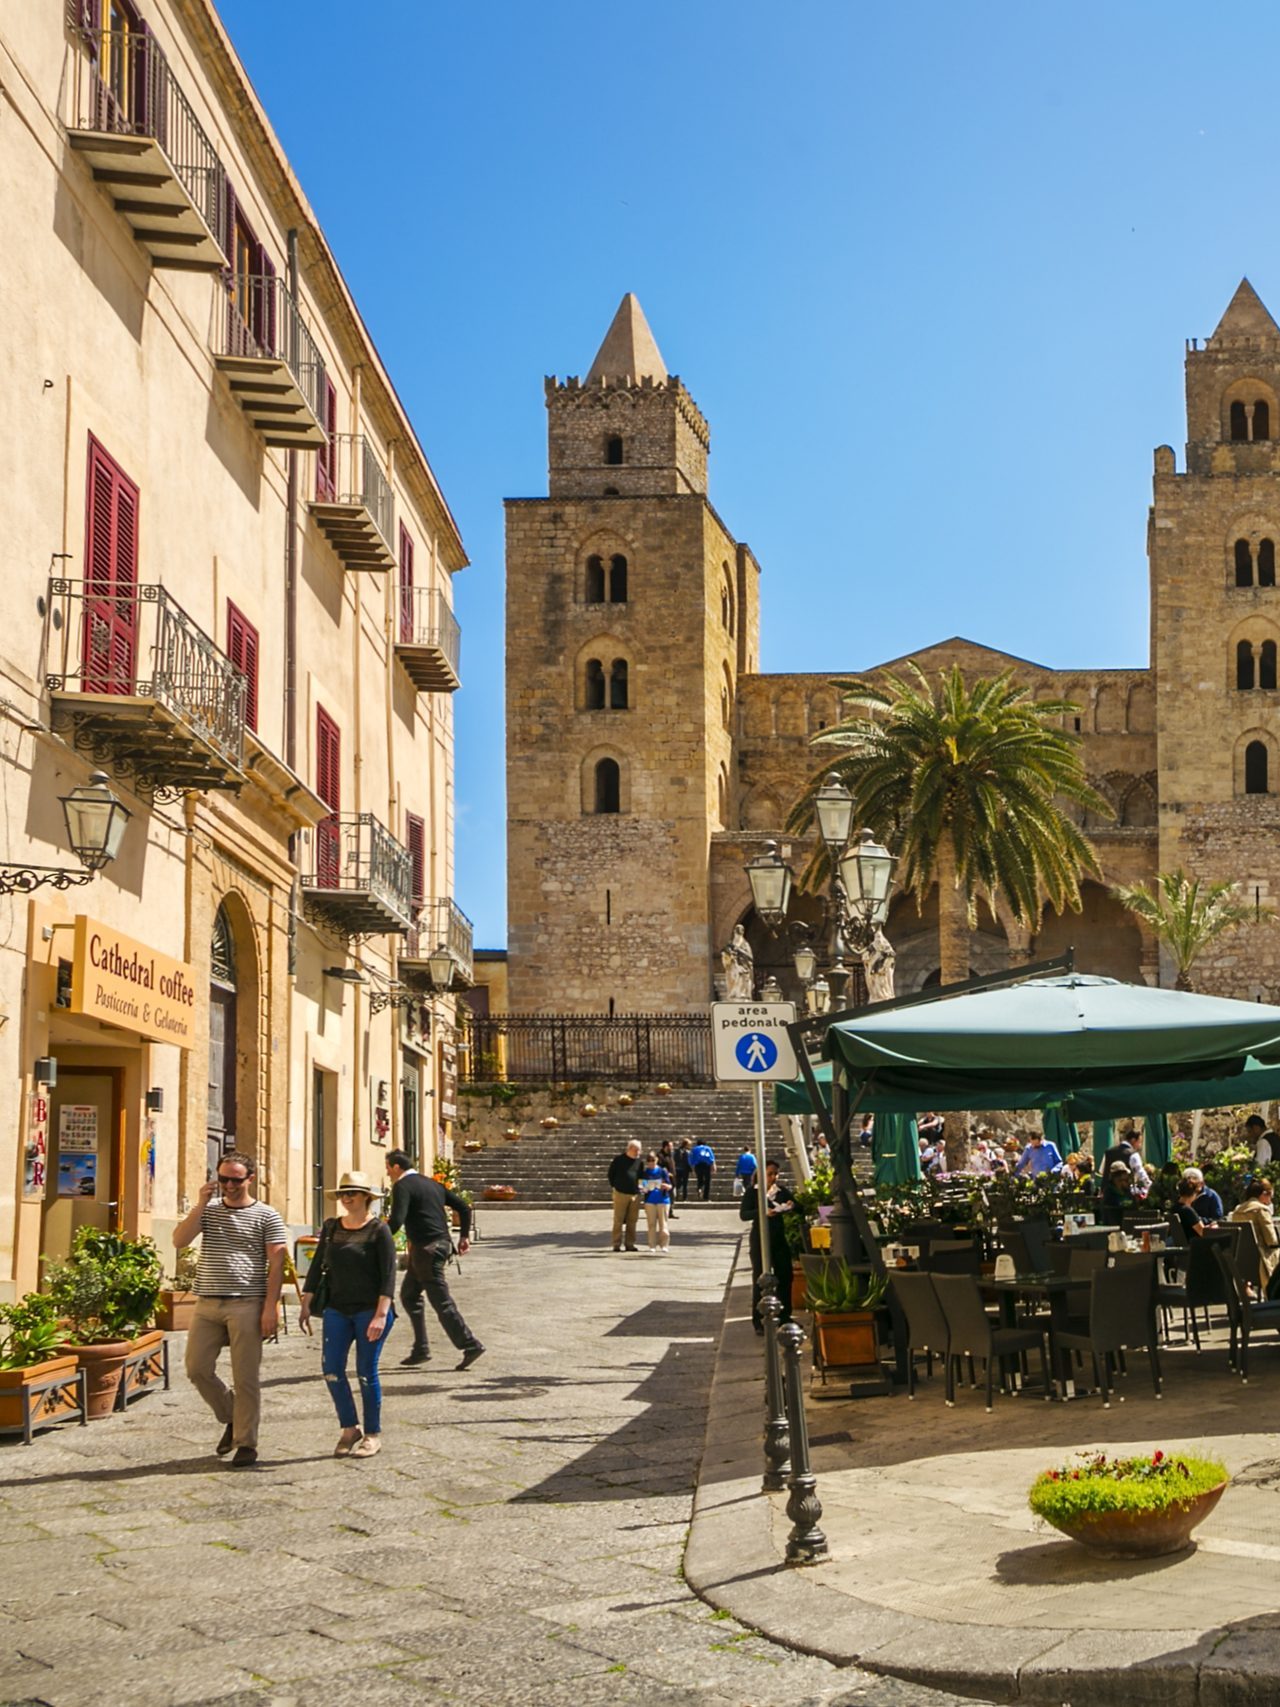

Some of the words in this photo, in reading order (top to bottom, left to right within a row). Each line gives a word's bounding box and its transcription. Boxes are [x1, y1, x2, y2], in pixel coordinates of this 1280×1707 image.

[90, 933, 154, 991] Cathedral
[159, 970, 194, 1007] coffee
[95, 984, 139, 1018] Pasticceria
[142, 1002, 151, 1023] &
[154, 1007, 188, 1036] Gelateria
[738, 1007, 768, 1015] area
[33, 1098, 47, 1186] BAR
